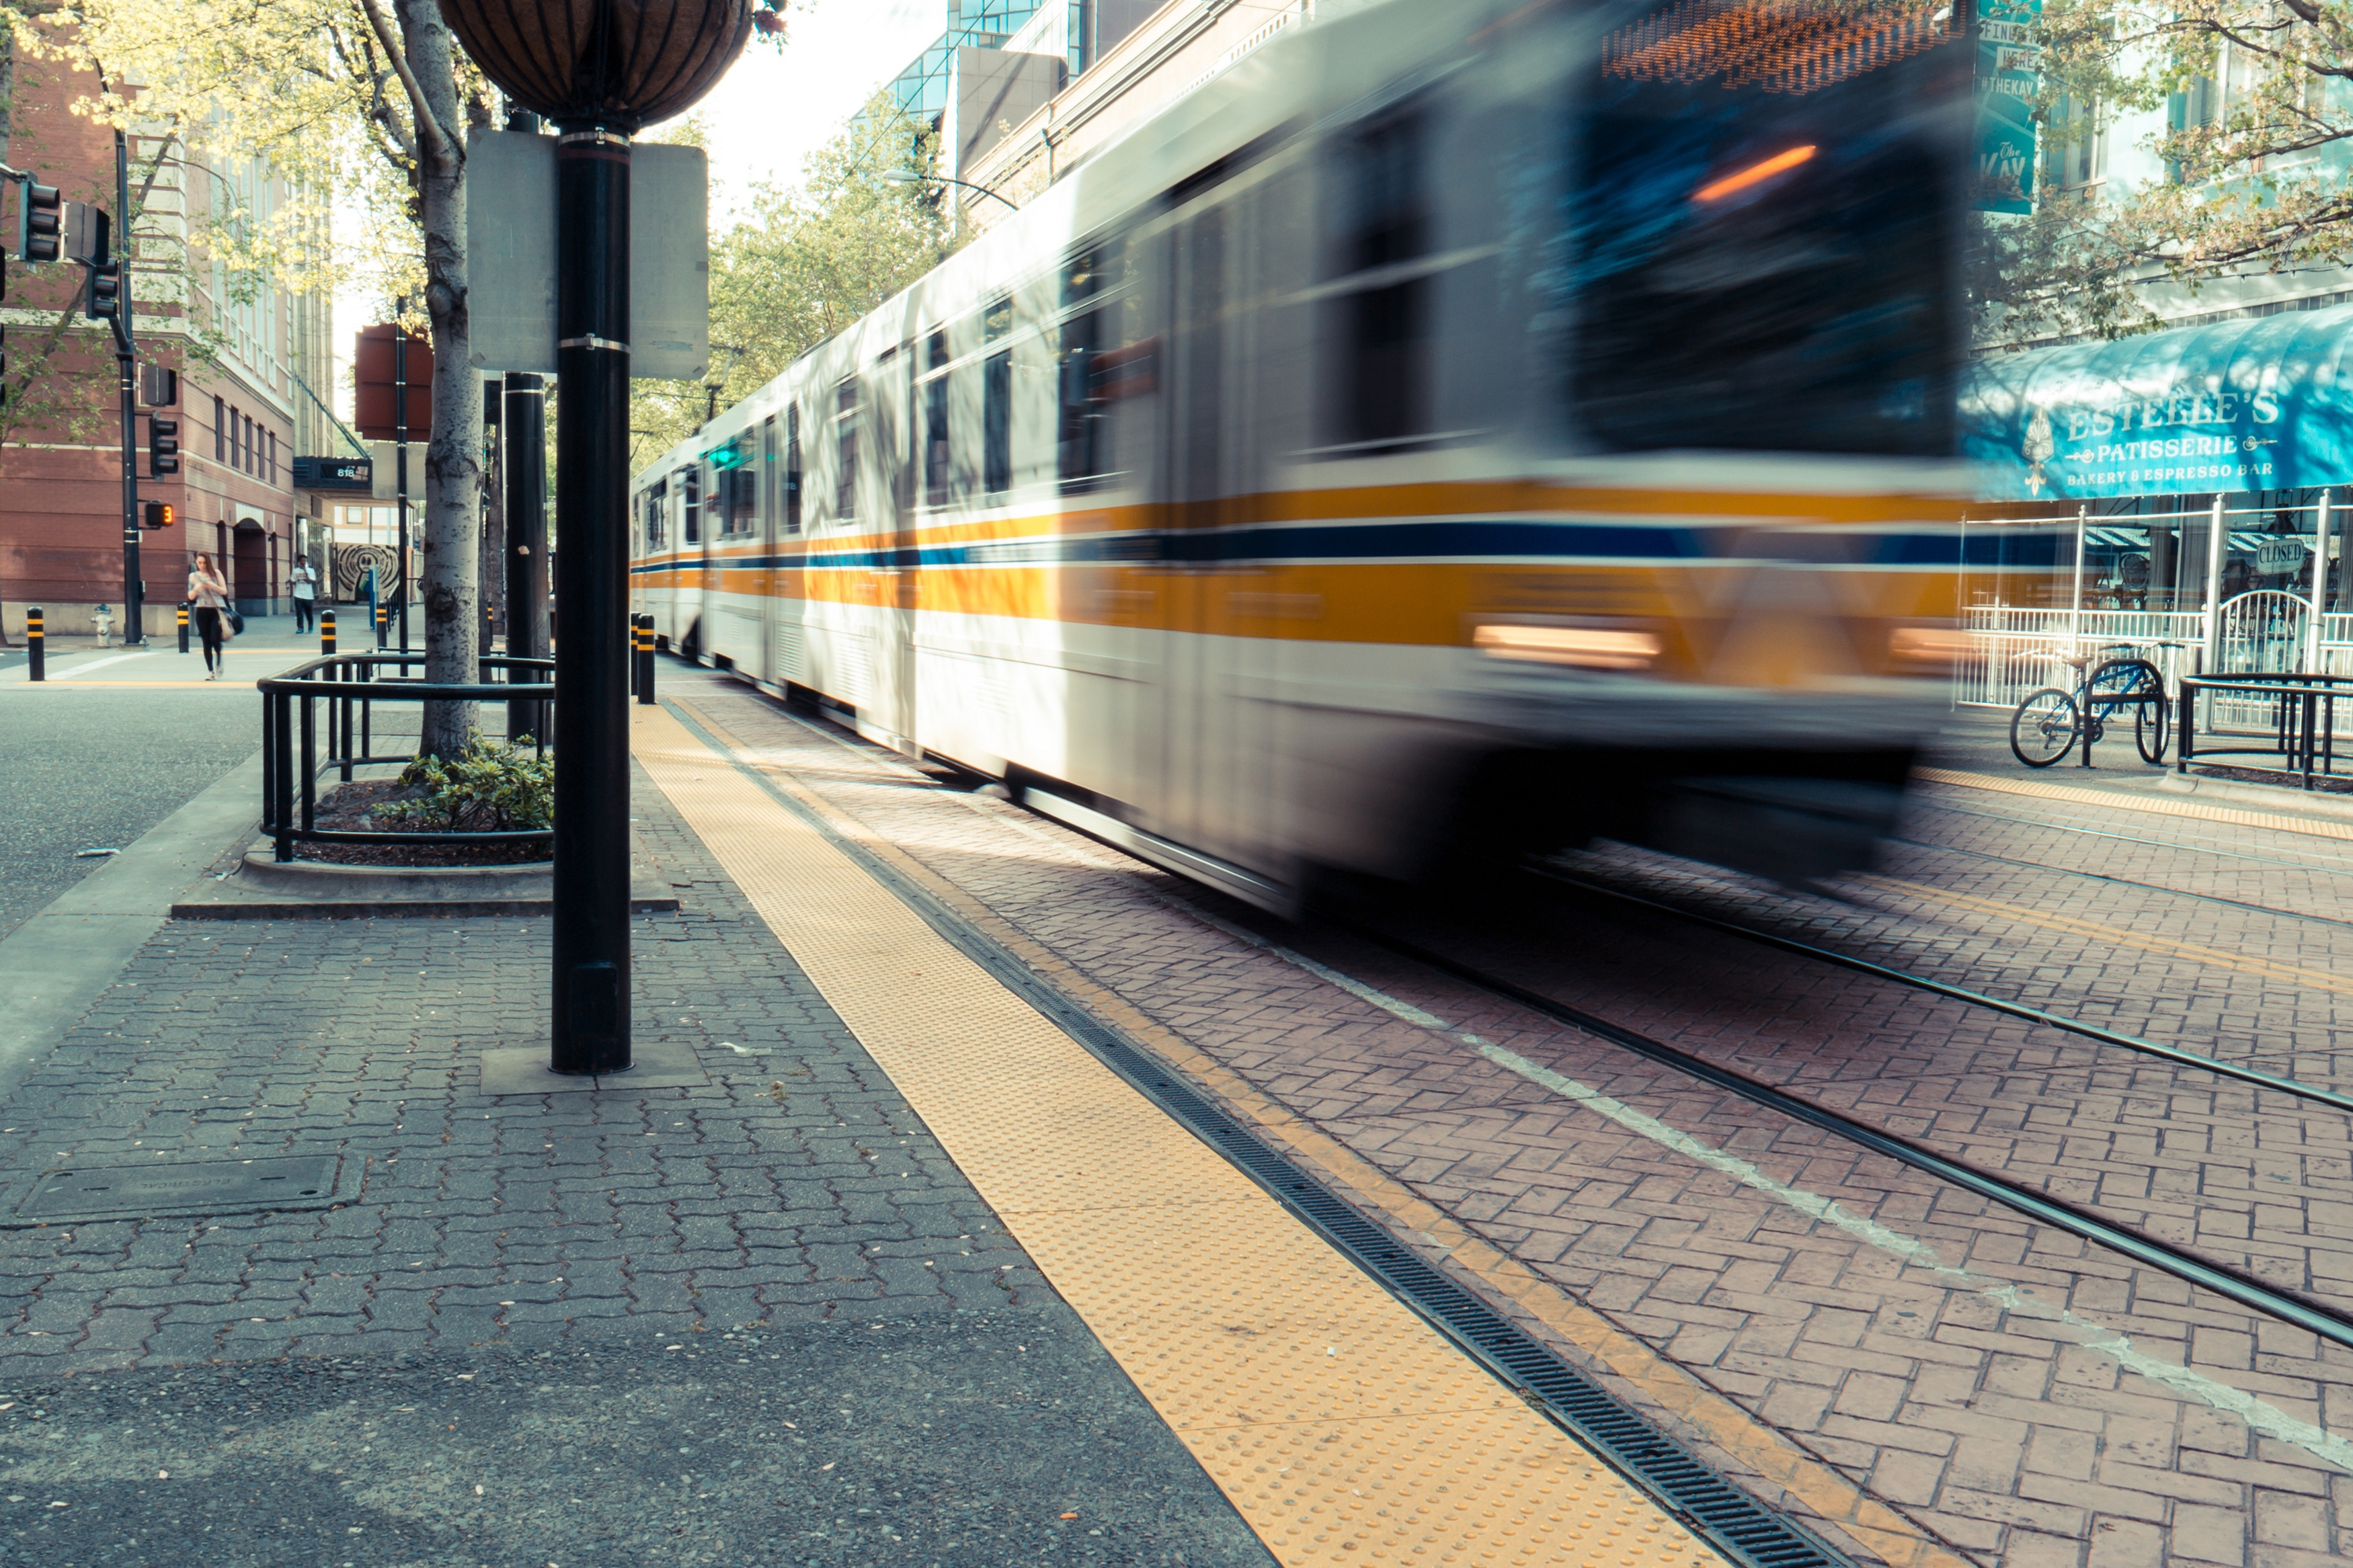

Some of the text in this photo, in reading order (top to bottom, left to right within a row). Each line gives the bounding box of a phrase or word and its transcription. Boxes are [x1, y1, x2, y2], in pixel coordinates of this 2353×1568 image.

[1981, 76, 2034, 95] #THEKAY
[1999, 141, 2021, 159] The
[1979, 151, 2026, 186] KAY
[2067, 391, 2278, 442] ESTELLE'S
[2097, 436, 2237, 462] PATISSERIE
[337, 468, 354, 477] 818
[2067, 462, 2272, 486] BAKERY & ESPRESSO BAR
[164, 505, 172, 523] 3
[2259, 544, 2301, 564] CLOSED
[141, 1178, 231, 1189] ELECTRICAL
